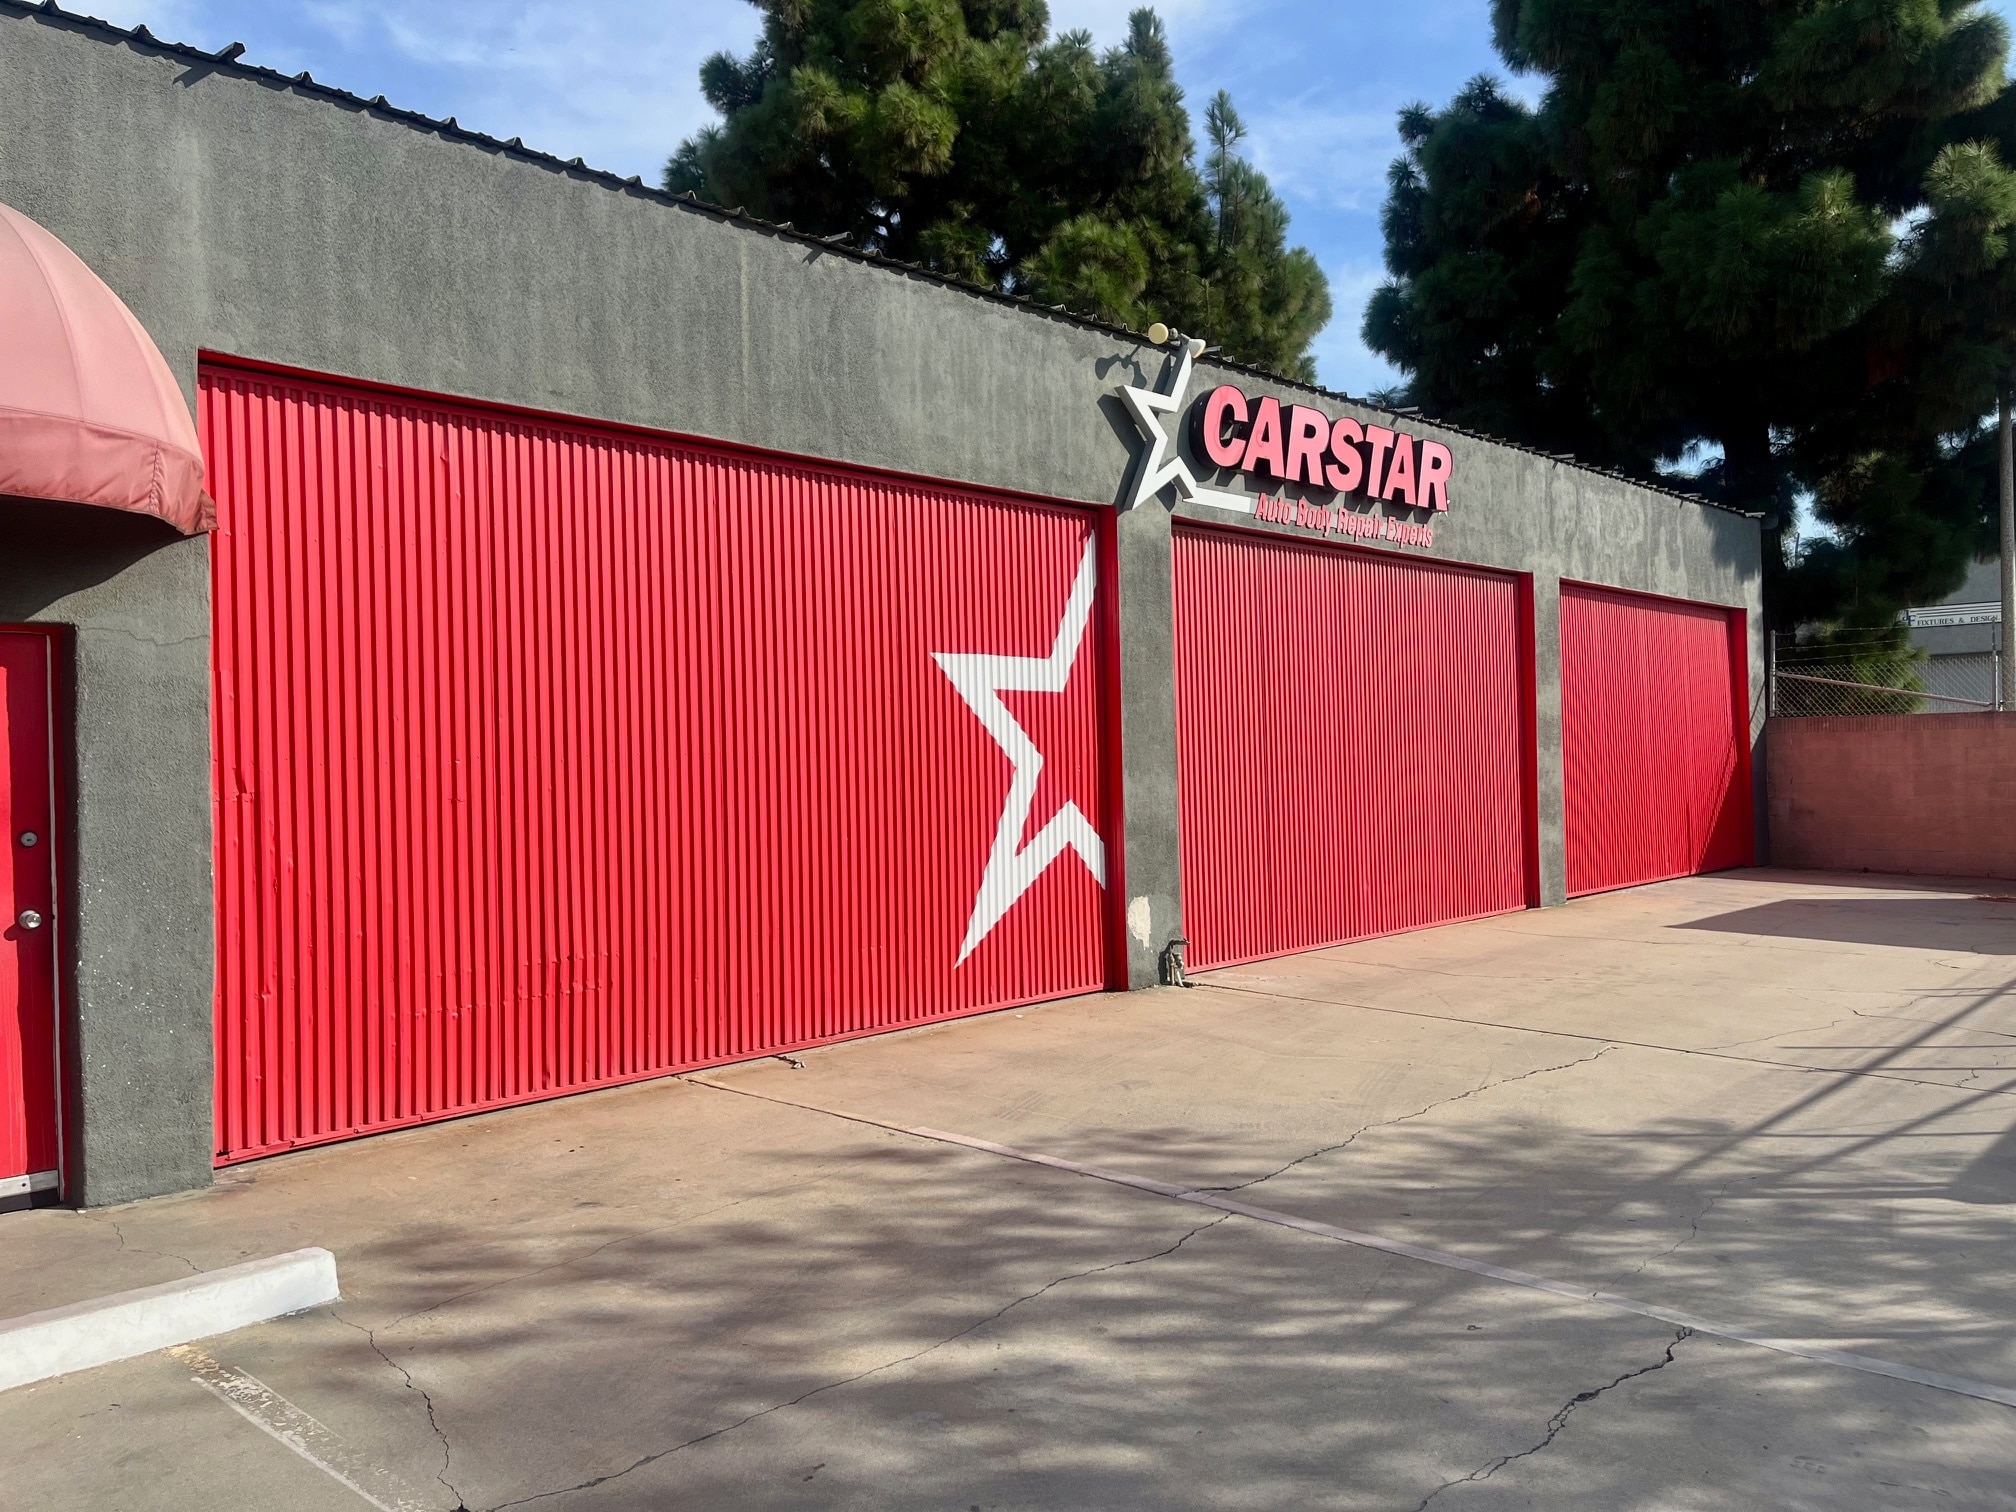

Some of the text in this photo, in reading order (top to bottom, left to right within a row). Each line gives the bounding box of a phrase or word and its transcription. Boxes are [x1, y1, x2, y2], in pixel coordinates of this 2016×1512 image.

[1204, 385, 1453, 511] CARSTAR
[1254, 492, 1434, 548] Auto Body Repair Experts
[1917, 618, 1955, 627] FIXTURES
[1970, 615, 1998, 623] DESIGN
